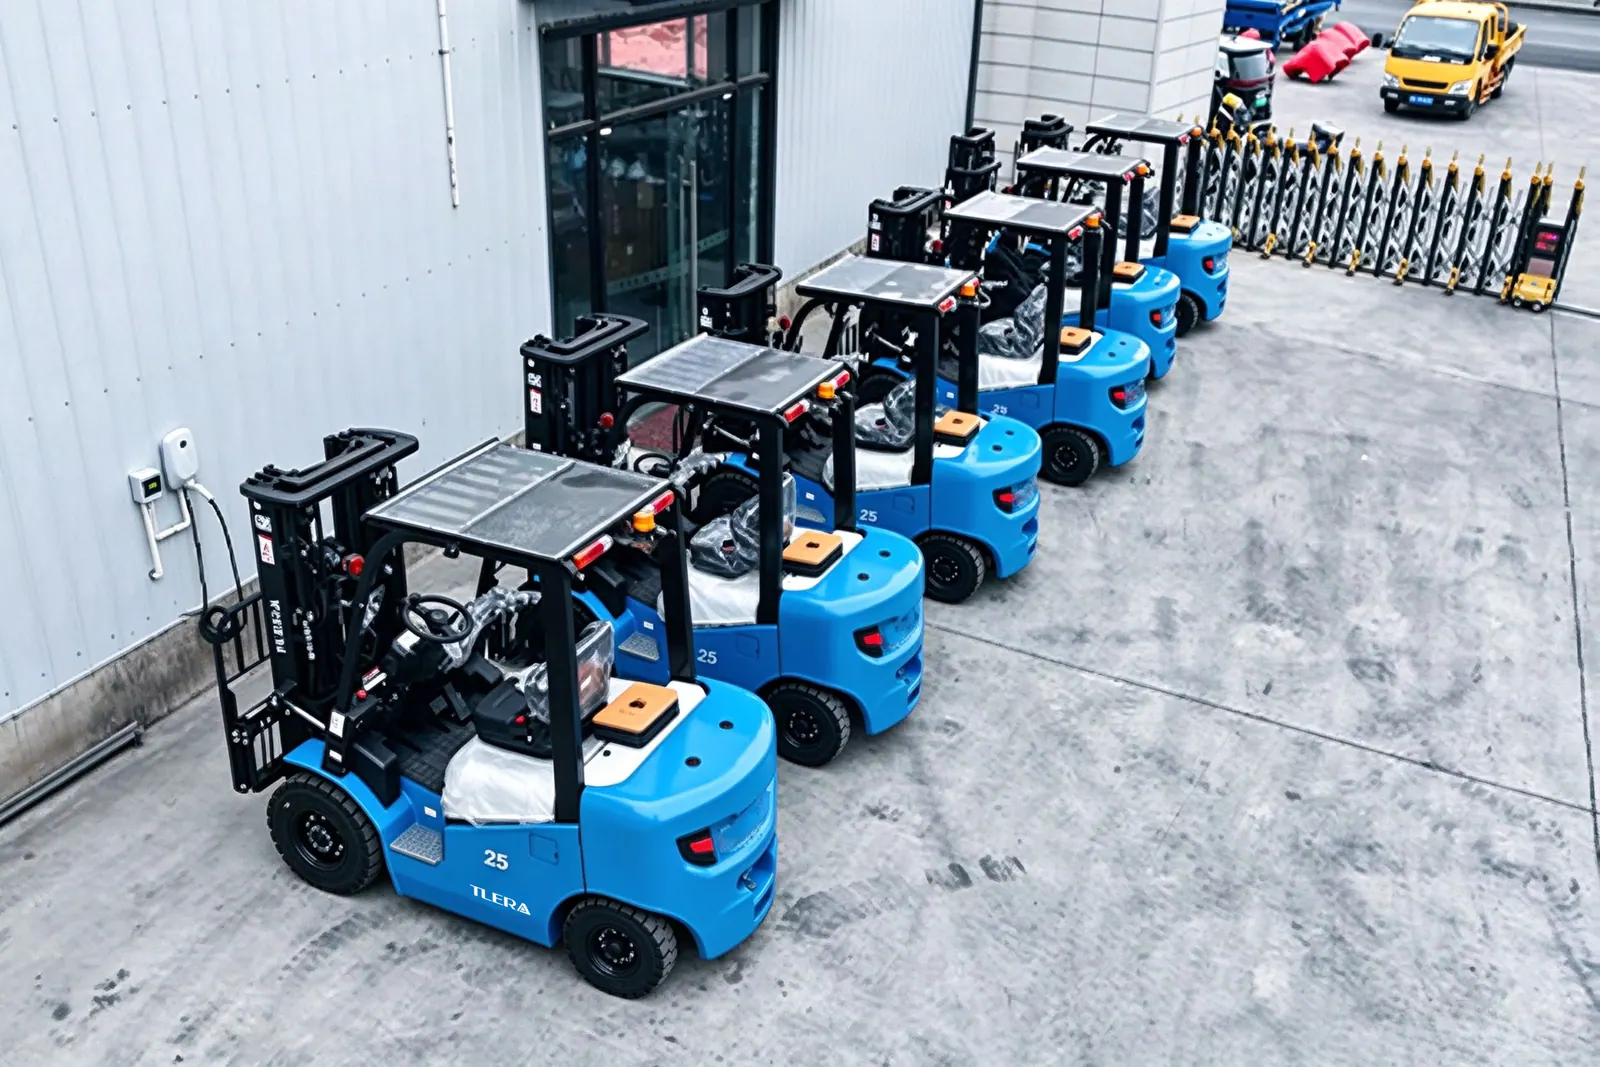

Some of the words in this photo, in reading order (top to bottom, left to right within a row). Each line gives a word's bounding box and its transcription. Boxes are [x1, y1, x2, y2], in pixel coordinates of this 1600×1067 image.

[860, 508, 878, 522] 25
[697, 648, 717, 665] 25
[483, 849, 509, 871] 25
